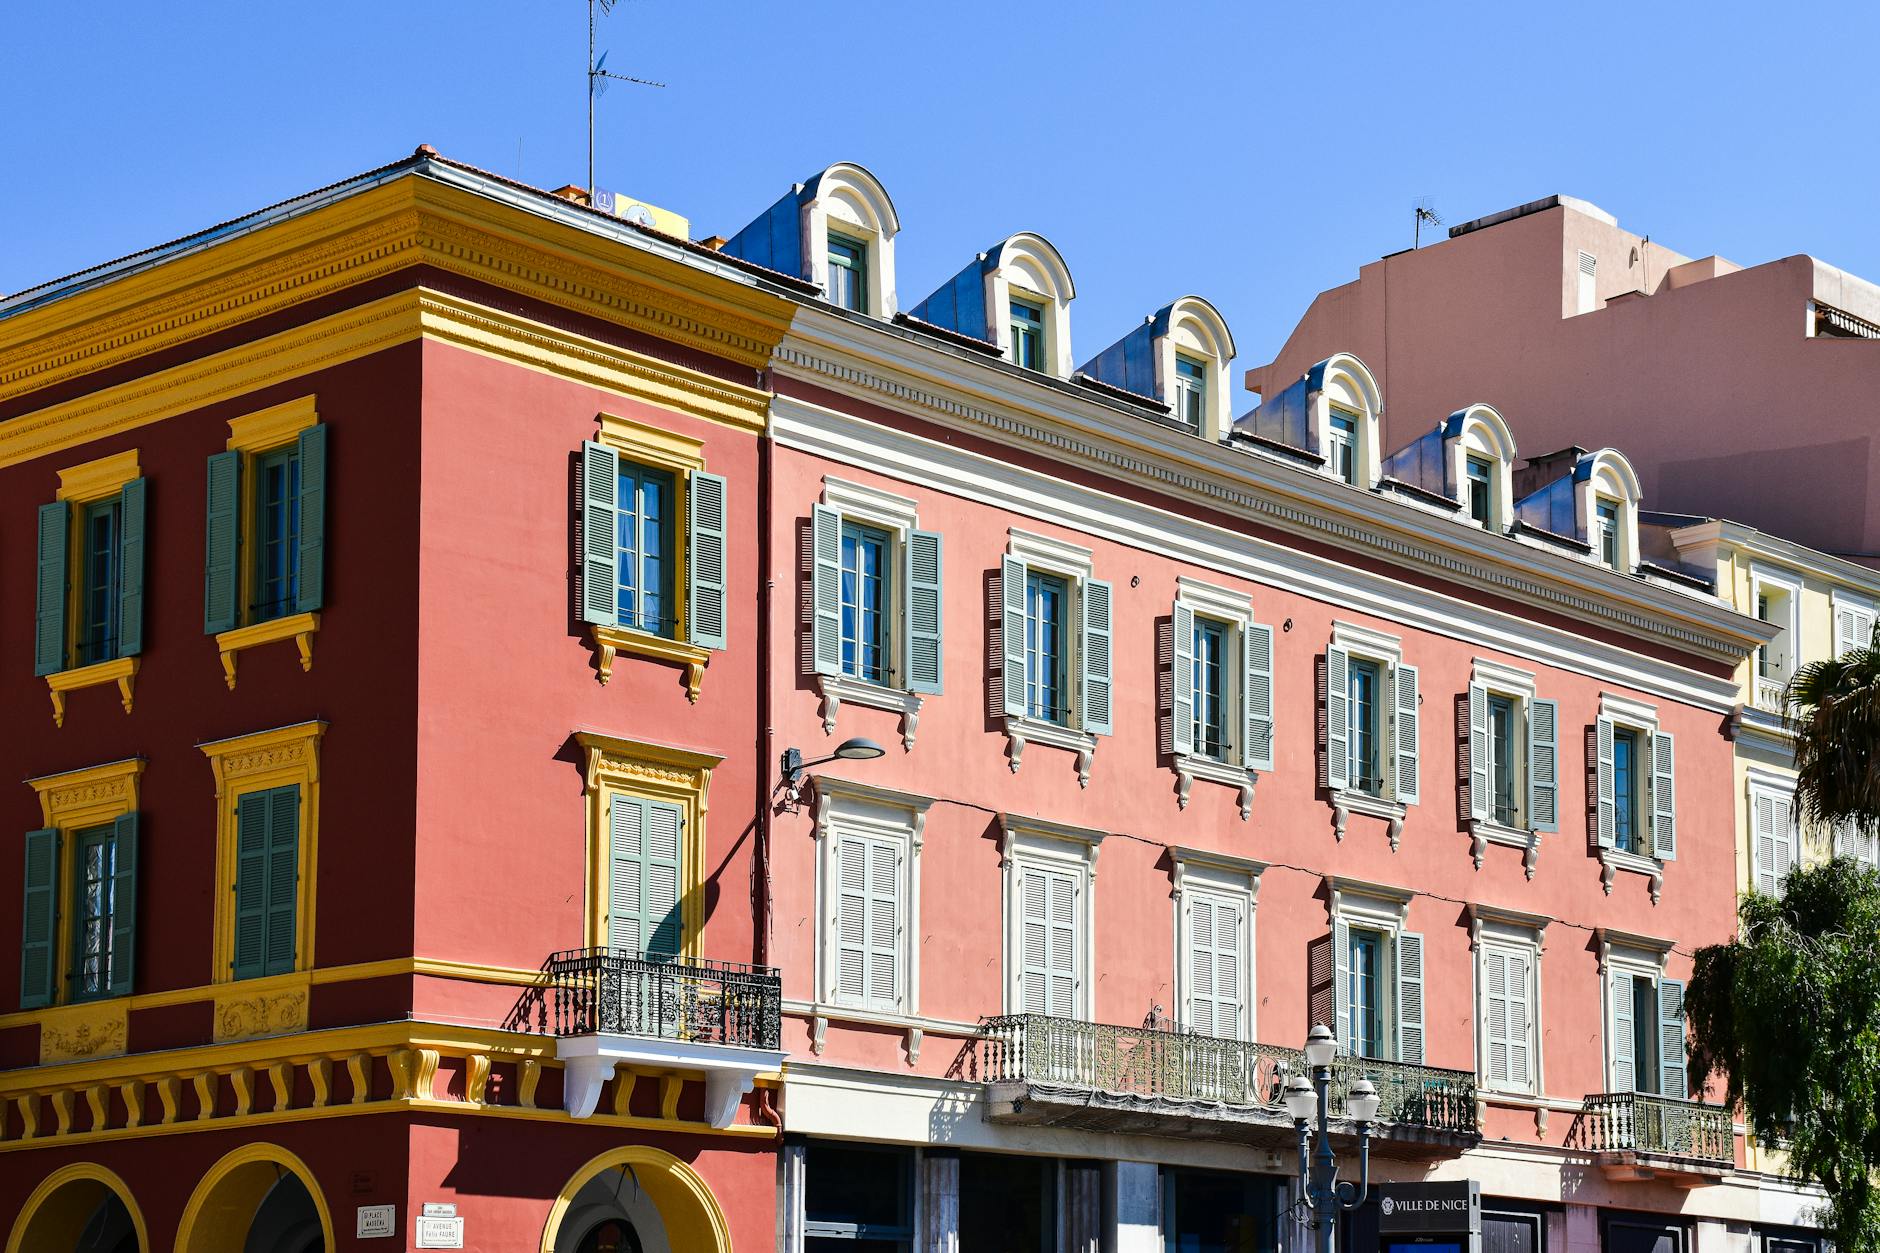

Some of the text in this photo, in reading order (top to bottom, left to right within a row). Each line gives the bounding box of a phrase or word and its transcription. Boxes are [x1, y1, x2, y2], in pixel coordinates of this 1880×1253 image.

[1395, 1199, 1468, 1211] VILLE DE NICE
[369, 1211, 383, 1219] PLACE
